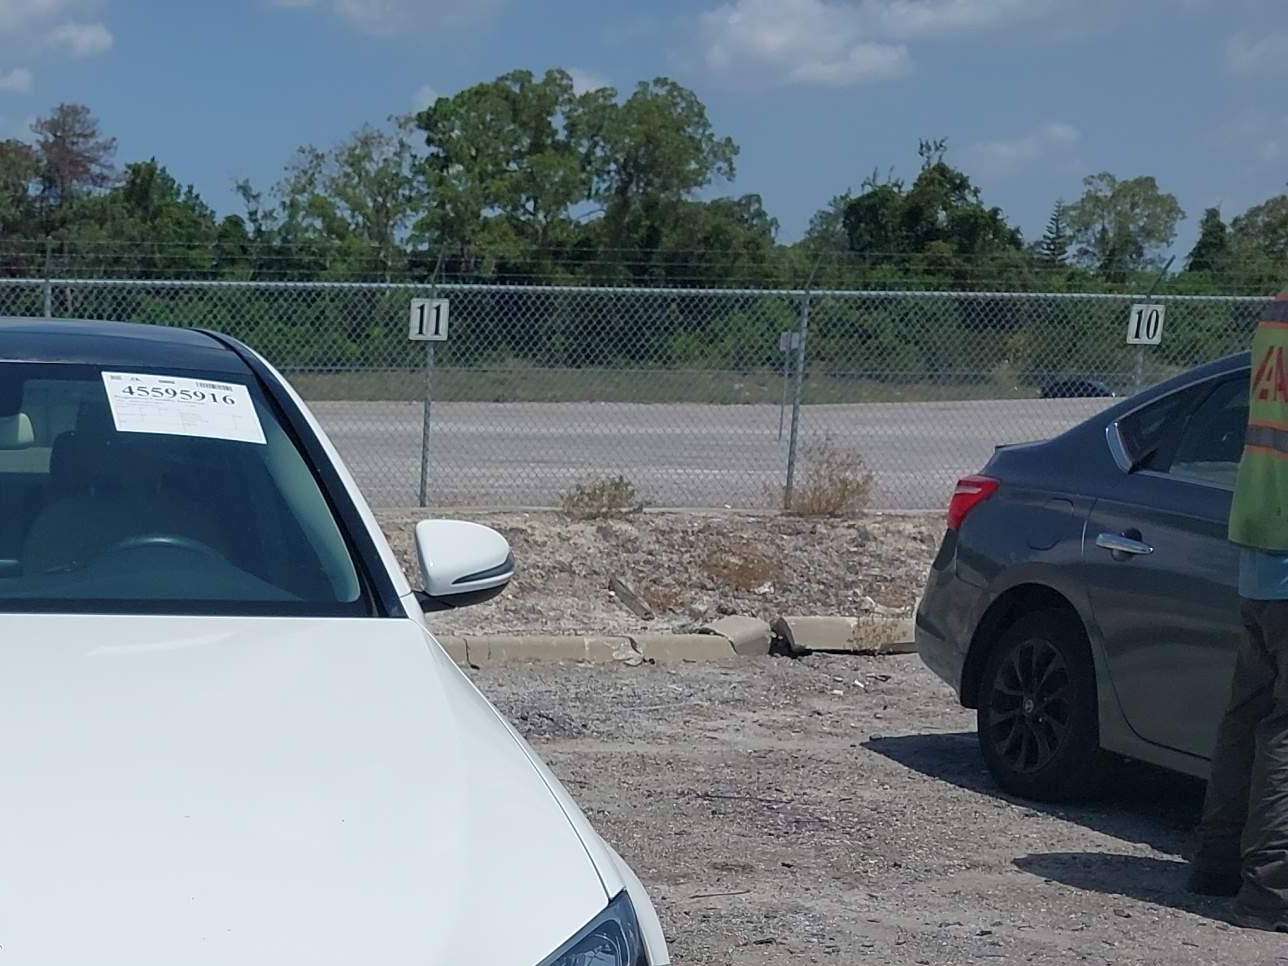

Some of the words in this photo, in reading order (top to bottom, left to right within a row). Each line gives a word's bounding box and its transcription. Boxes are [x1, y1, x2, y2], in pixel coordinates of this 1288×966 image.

[415, 303, 441, 336] 11
[1134, 309, 1160, 340] 10
[122, 385, 236, 405] 45595916
